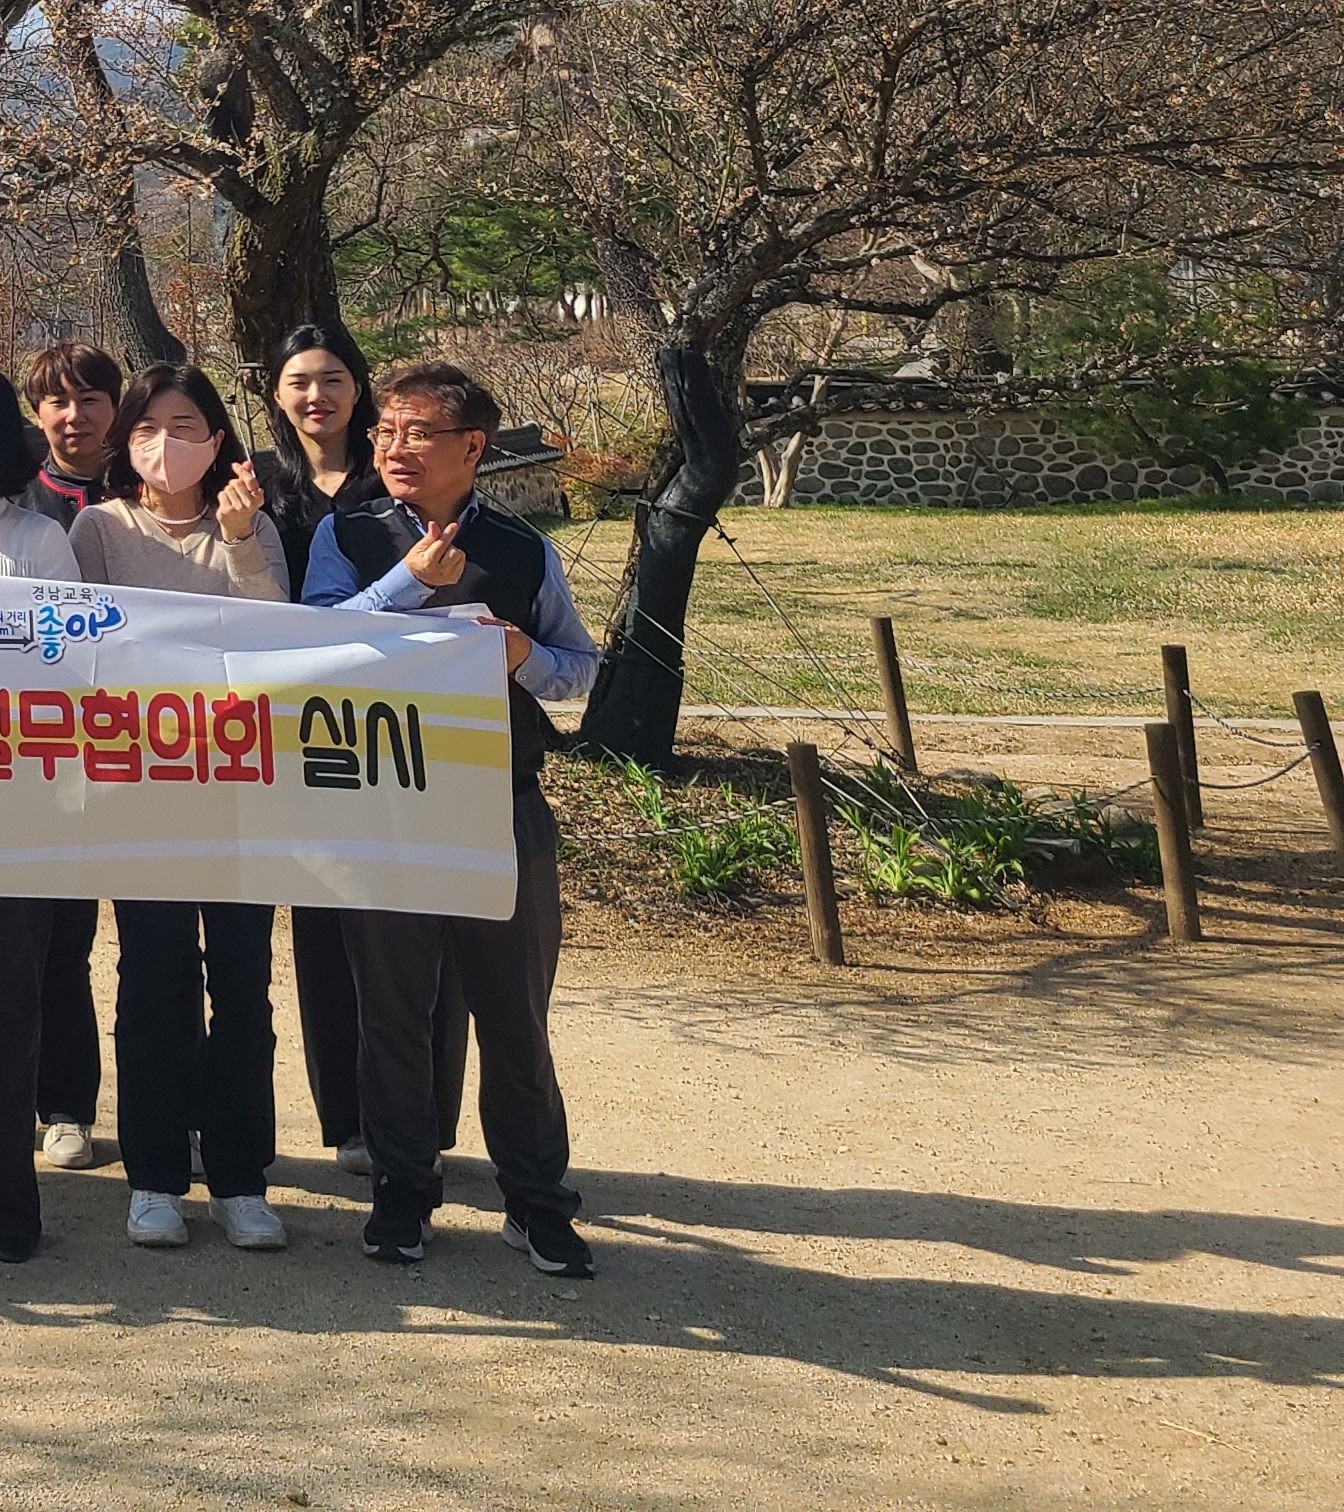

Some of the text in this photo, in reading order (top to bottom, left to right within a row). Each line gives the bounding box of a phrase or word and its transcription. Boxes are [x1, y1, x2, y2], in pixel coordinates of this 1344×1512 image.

[32, 586, 94, 601] 경남교육
[6, 610, 27, 623] 거리
[297, 695, 428, 792] 실시
